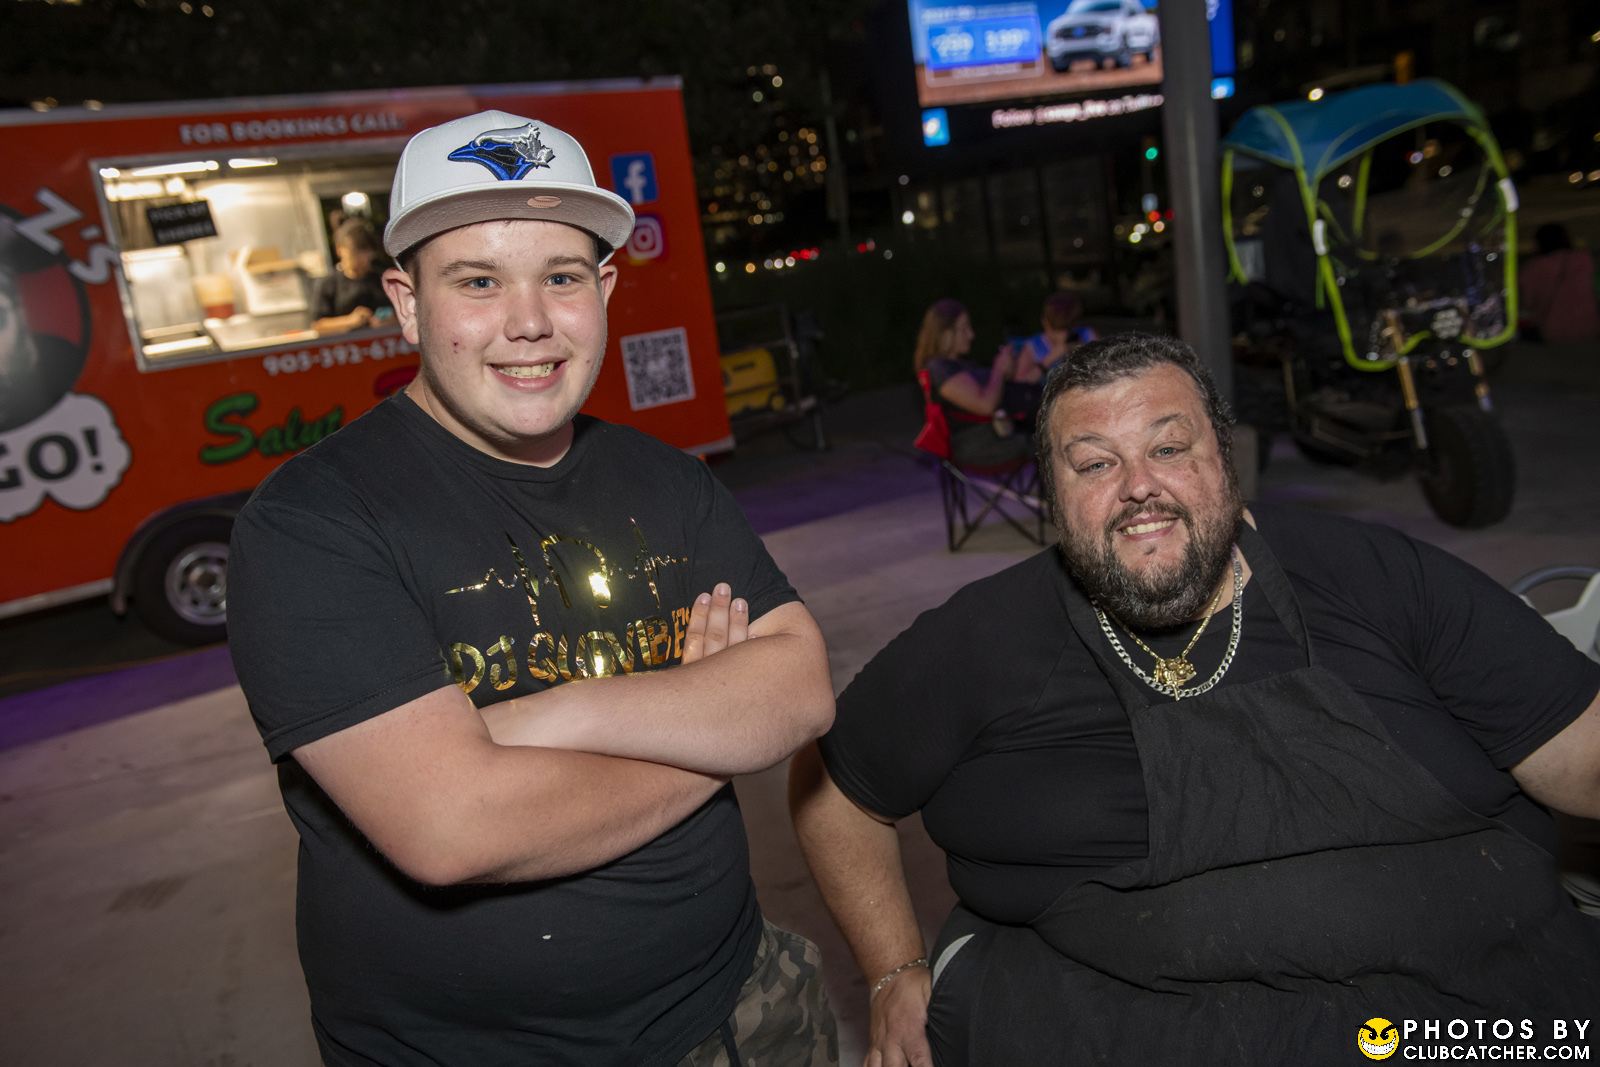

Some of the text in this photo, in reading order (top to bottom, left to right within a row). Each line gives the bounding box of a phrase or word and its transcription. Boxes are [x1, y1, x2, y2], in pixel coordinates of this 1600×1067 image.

[180, 111, 402, 145] FOR BOOKINGS CALL
[449, 634, 518, 695] DJ
